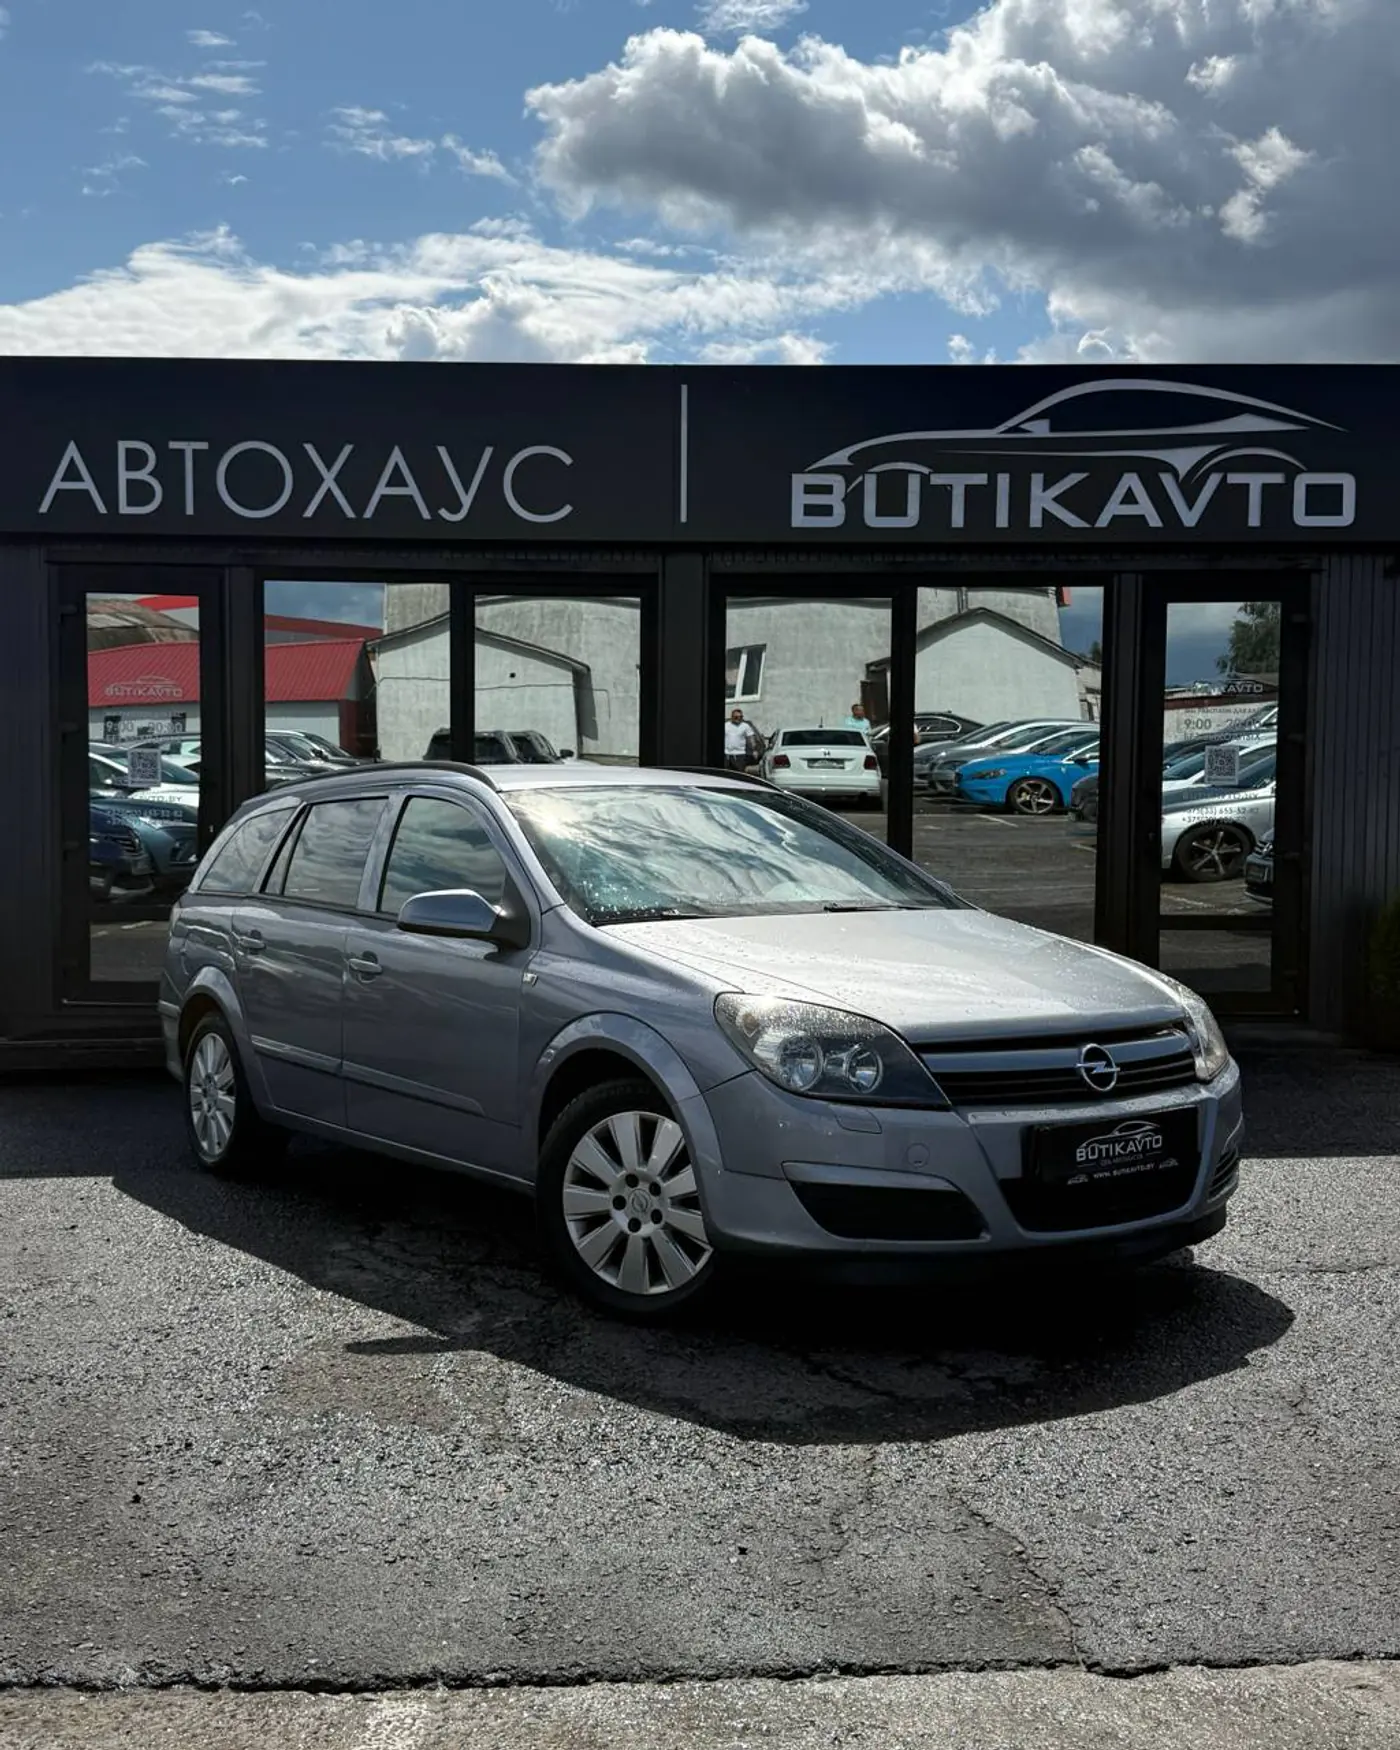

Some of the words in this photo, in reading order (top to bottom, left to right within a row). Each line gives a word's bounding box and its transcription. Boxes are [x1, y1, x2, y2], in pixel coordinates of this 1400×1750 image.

[38, 440, 573, 522] АВТОХАУС
[791, 473, 1356, 528] BUTIKAVTO
[1184, 719, 1212, 730] 9:00
[1076, 1135, 1162, 1161] BUTIKAVTO
